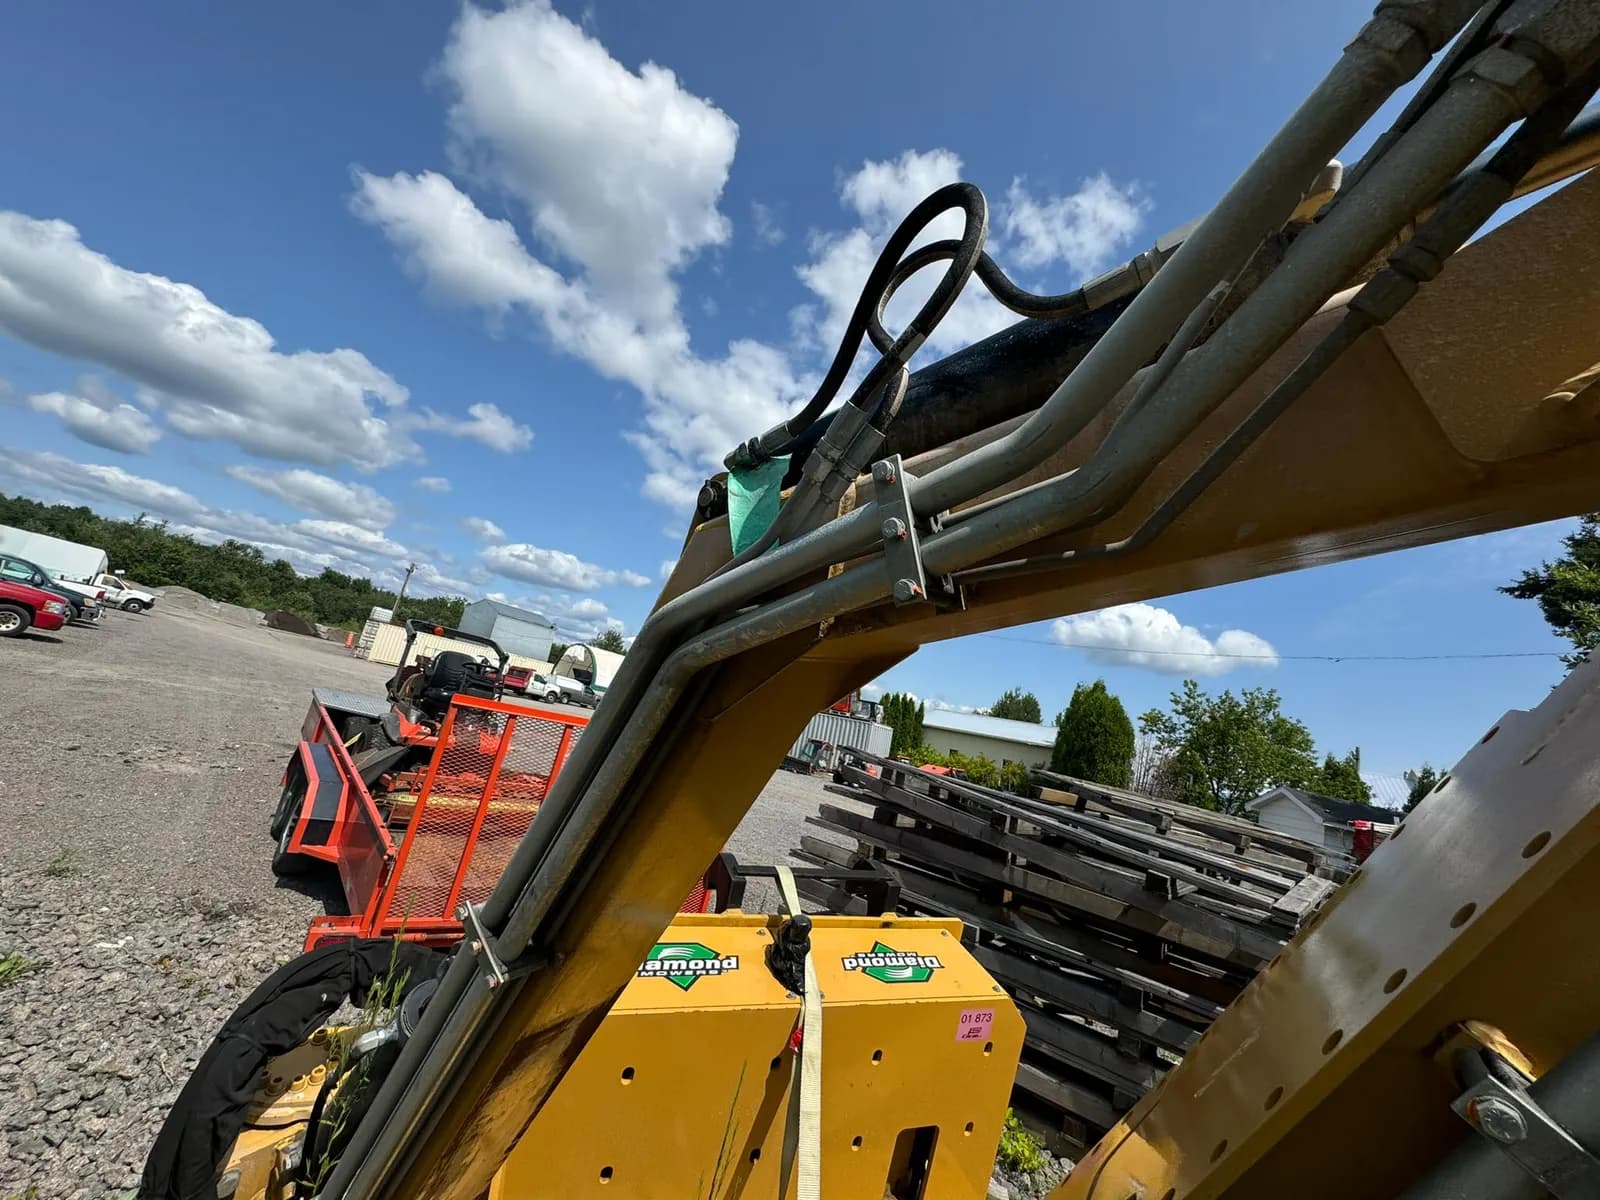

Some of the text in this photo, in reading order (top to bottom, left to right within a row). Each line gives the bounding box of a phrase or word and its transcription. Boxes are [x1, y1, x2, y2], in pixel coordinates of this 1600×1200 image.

[843, 957, 941, 970] Diamond
[961, 1012, 992, 1024] 01 873
